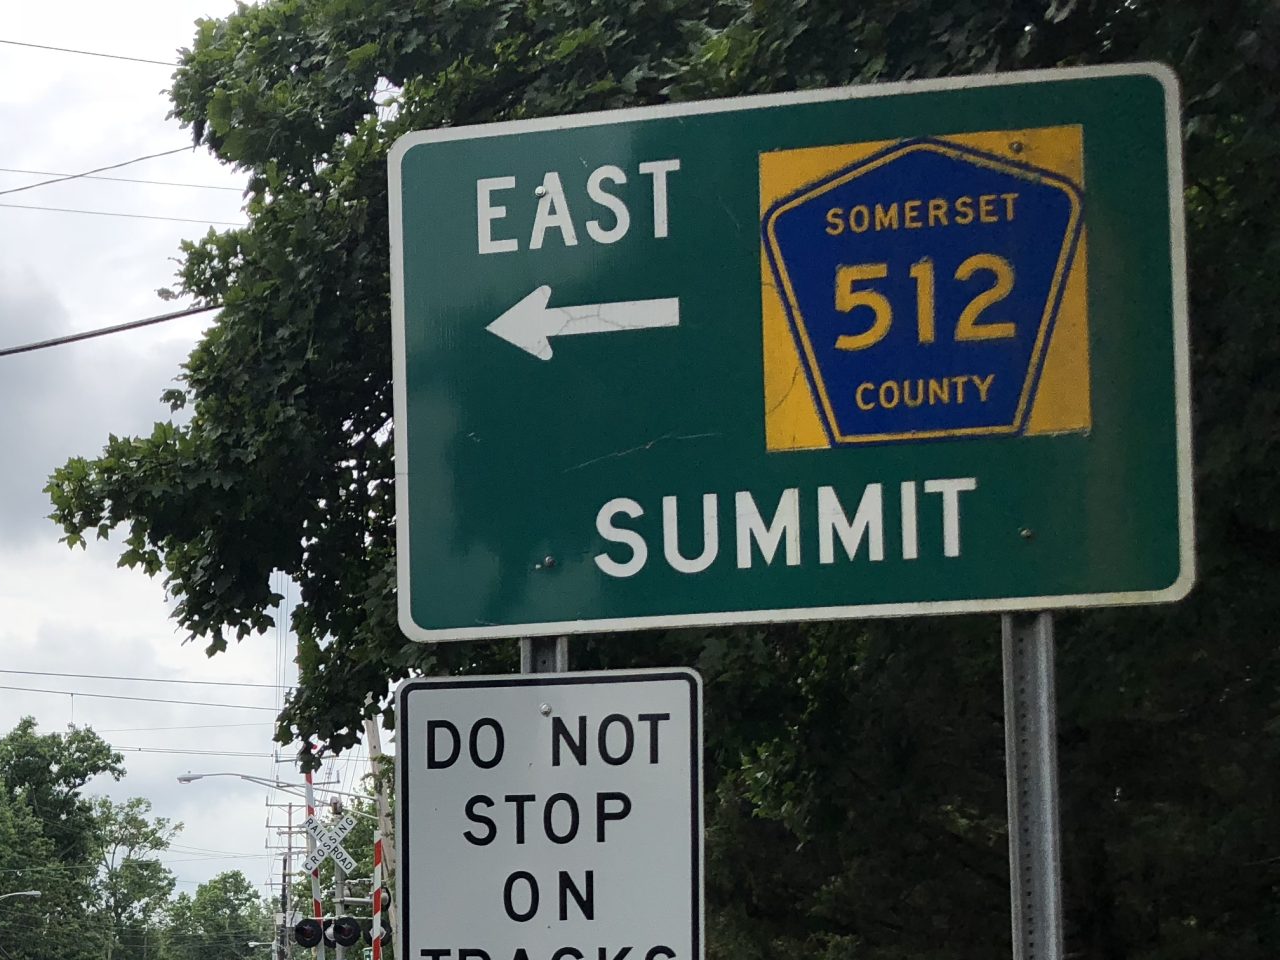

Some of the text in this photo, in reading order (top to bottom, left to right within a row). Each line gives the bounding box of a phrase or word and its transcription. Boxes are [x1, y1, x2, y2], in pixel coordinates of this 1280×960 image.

[476, 158, 681, 255] EAST
[825, 192, 1019, 237] SOMERSET
[833, 253, 1017, 352] 512
[855, 374, 996, 412] COUNTY
[594, 477, 978, 579] SUMMIT
[426, 712, 671, 770] DO NOT
[304, 817, 354, 871] CROSSING
[462, 791, 633, 847] STOP
[503, 870, 595, 923] ON
